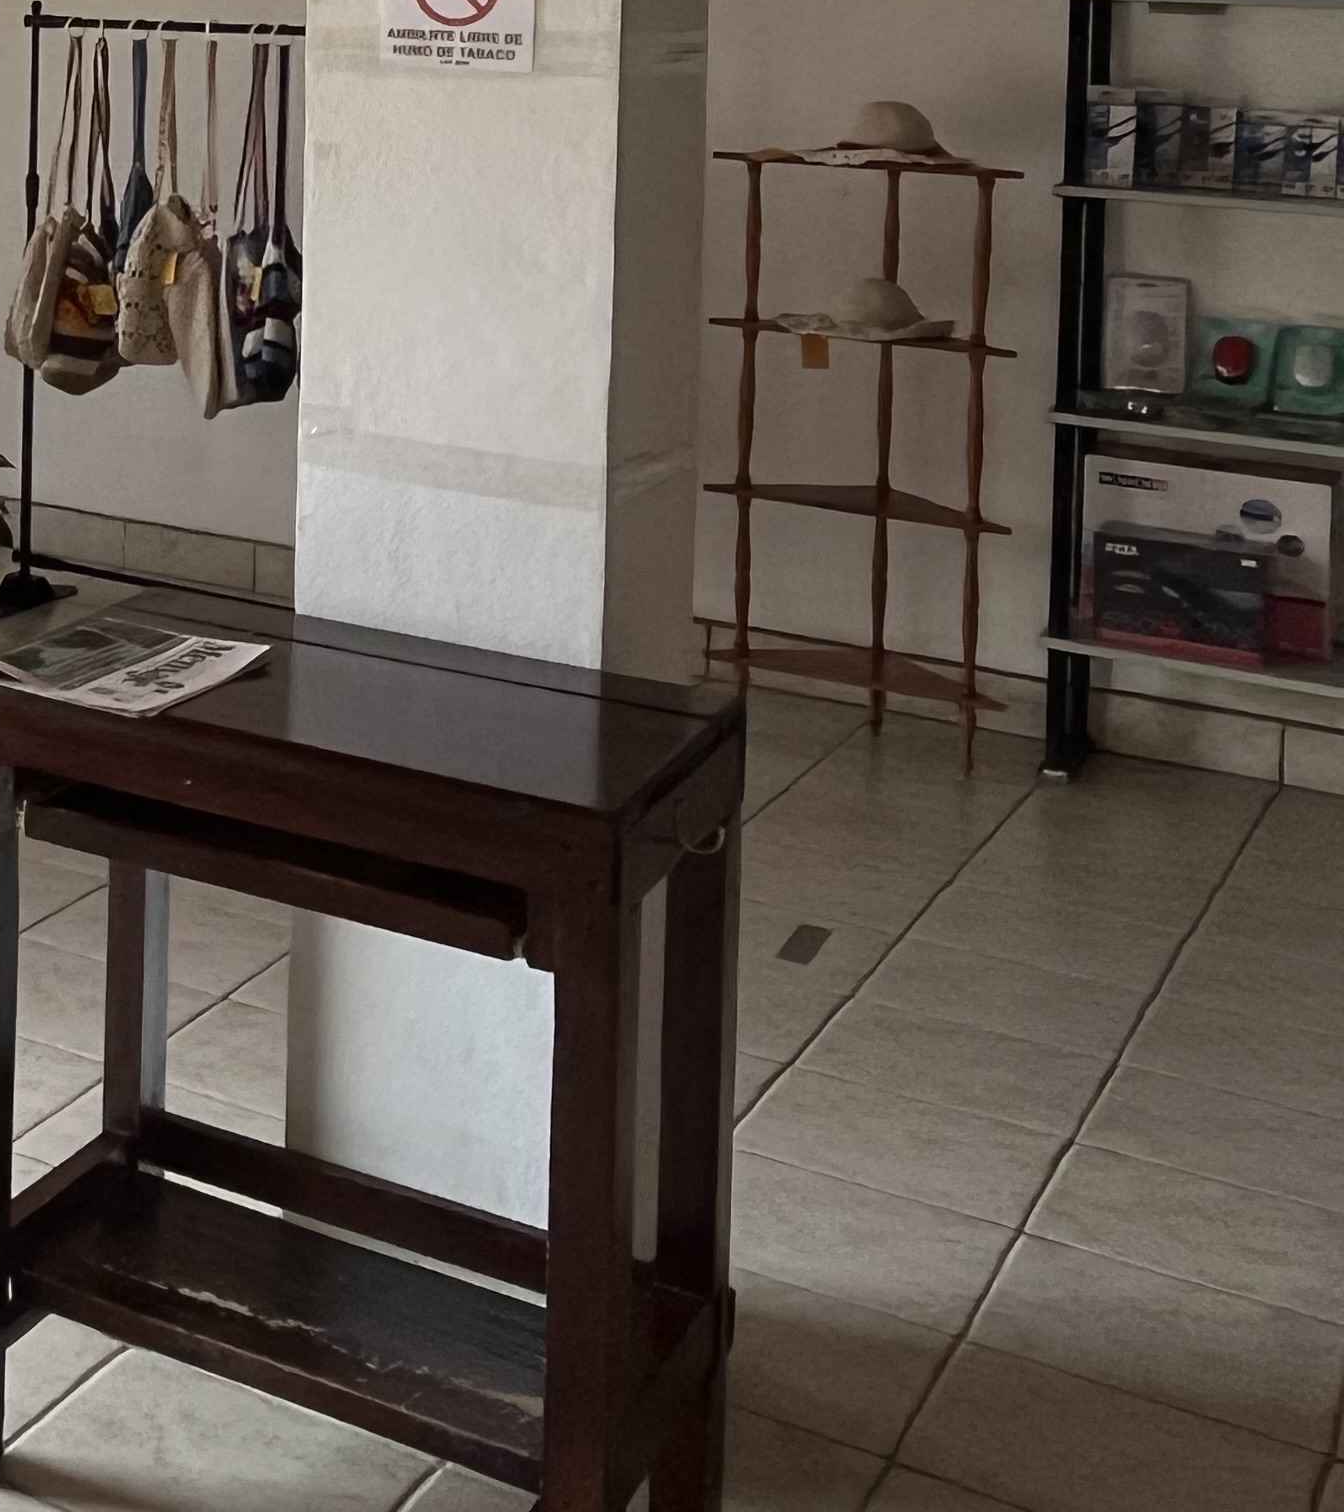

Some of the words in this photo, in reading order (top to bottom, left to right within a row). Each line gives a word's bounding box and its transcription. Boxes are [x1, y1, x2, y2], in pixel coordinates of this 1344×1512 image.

[504, 33, 523, 45] DE
[437, 46, 454, 57] DE
[460, 47, 516, 60] TABACO
